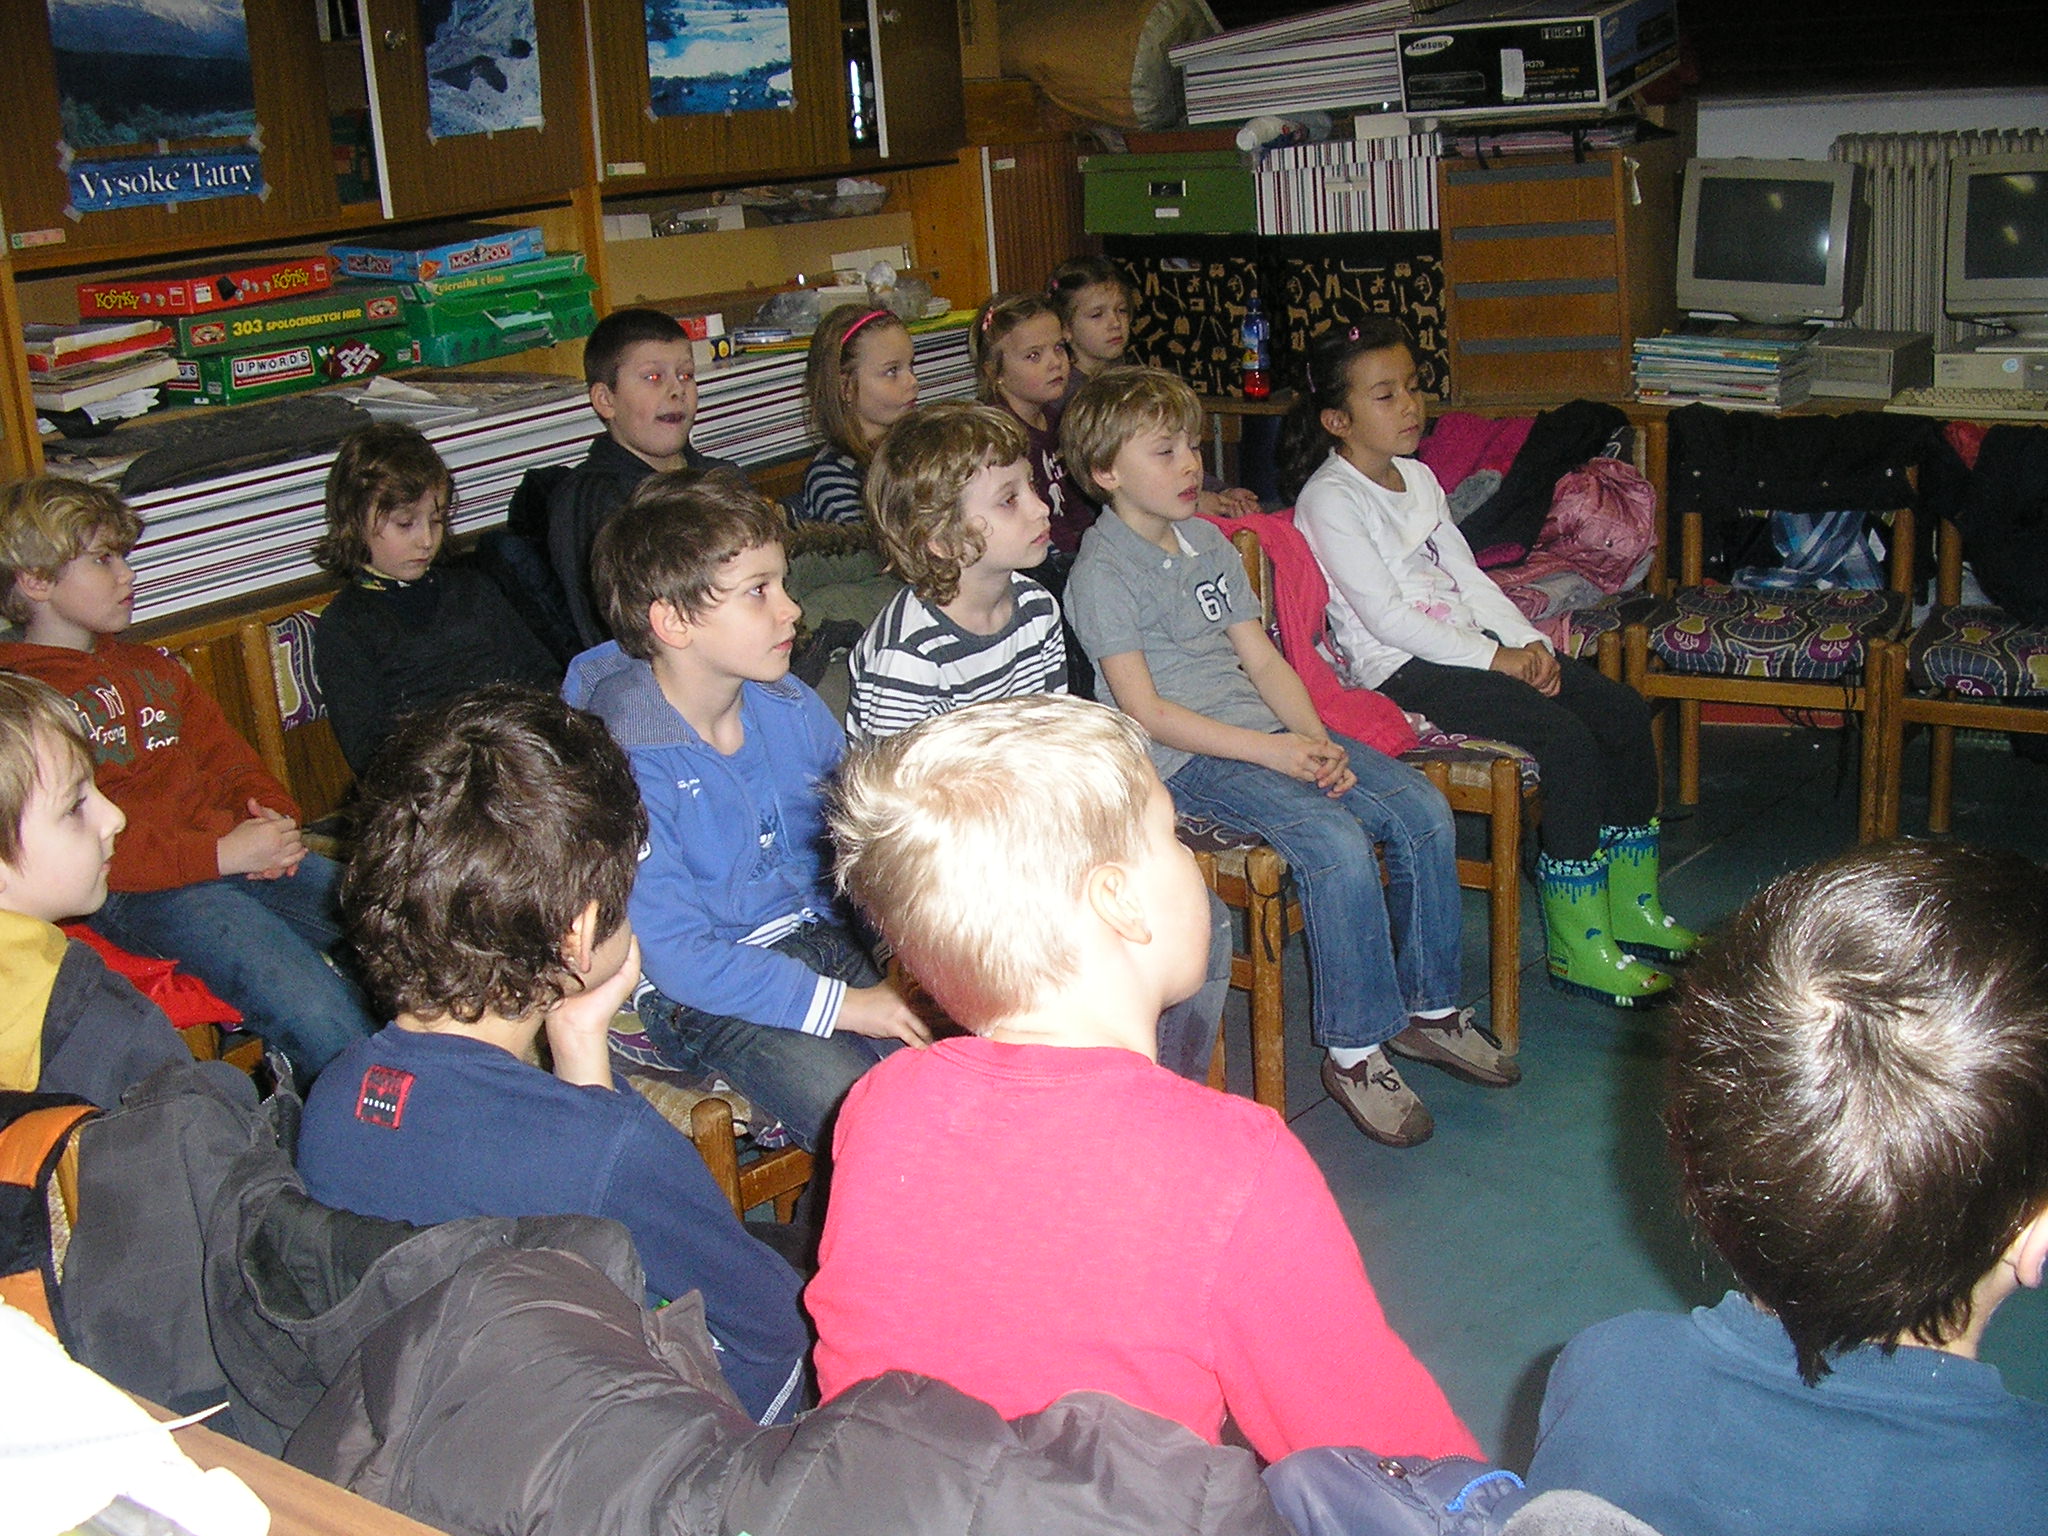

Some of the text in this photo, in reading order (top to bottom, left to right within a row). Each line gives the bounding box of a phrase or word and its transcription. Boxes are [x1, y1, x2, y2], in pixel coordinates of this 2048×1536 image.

[79, 161, 255, 206] Vysoké Tatry
[349, 257, 390, 273] MONPOLY
[452, 245, 511, 269] MONPOLY
[271, 266, 310, 290] KOSTKY
[94, 288, 140, 310] KOSTKY
[232, 319, 263, 337] 303
[236, 351, 309, 374] UPWORDS
[139, 706, 168, 728] De
